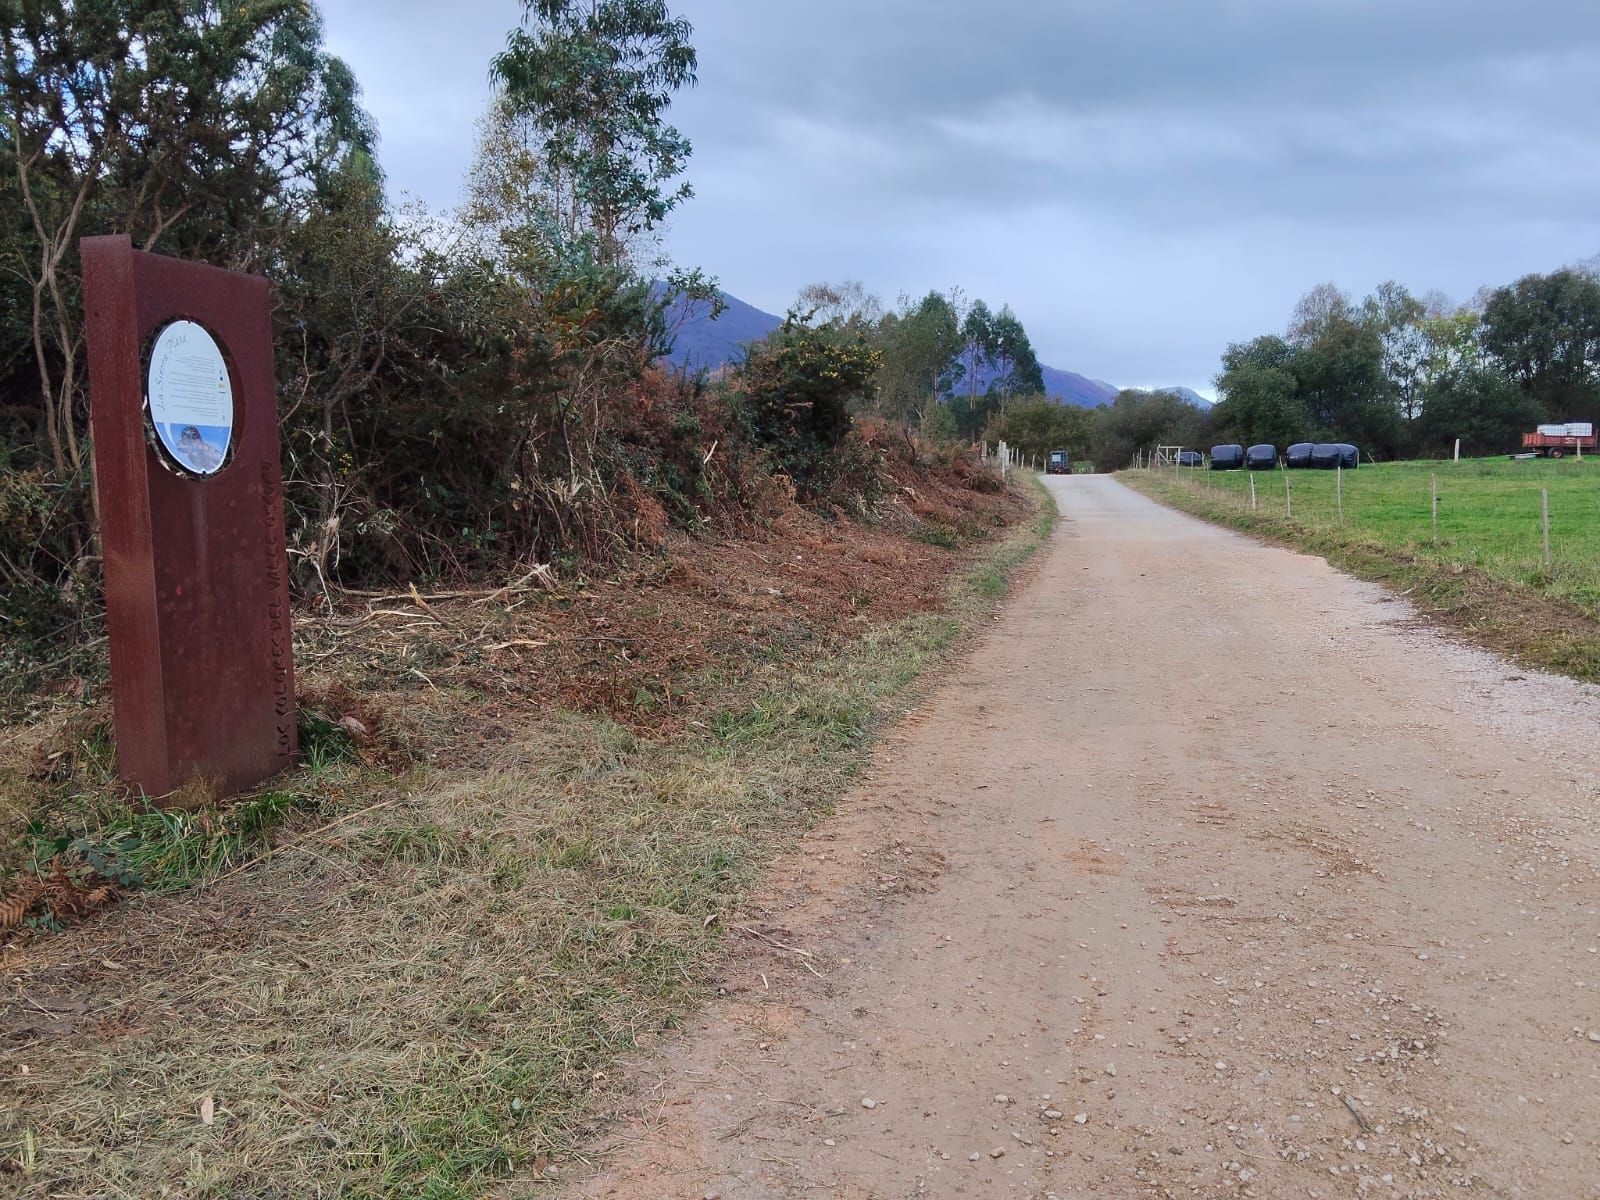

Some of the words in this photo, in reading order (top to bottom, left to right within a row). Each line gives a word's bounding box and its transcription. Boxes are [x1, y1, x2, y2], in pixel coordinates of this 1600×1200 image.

[264, 536, 280, 592] VALLE
[268, 596, 282, 631] DEL
[271, 637, 288, 716] COLORES
[276, 724, 290, 757] LOS
